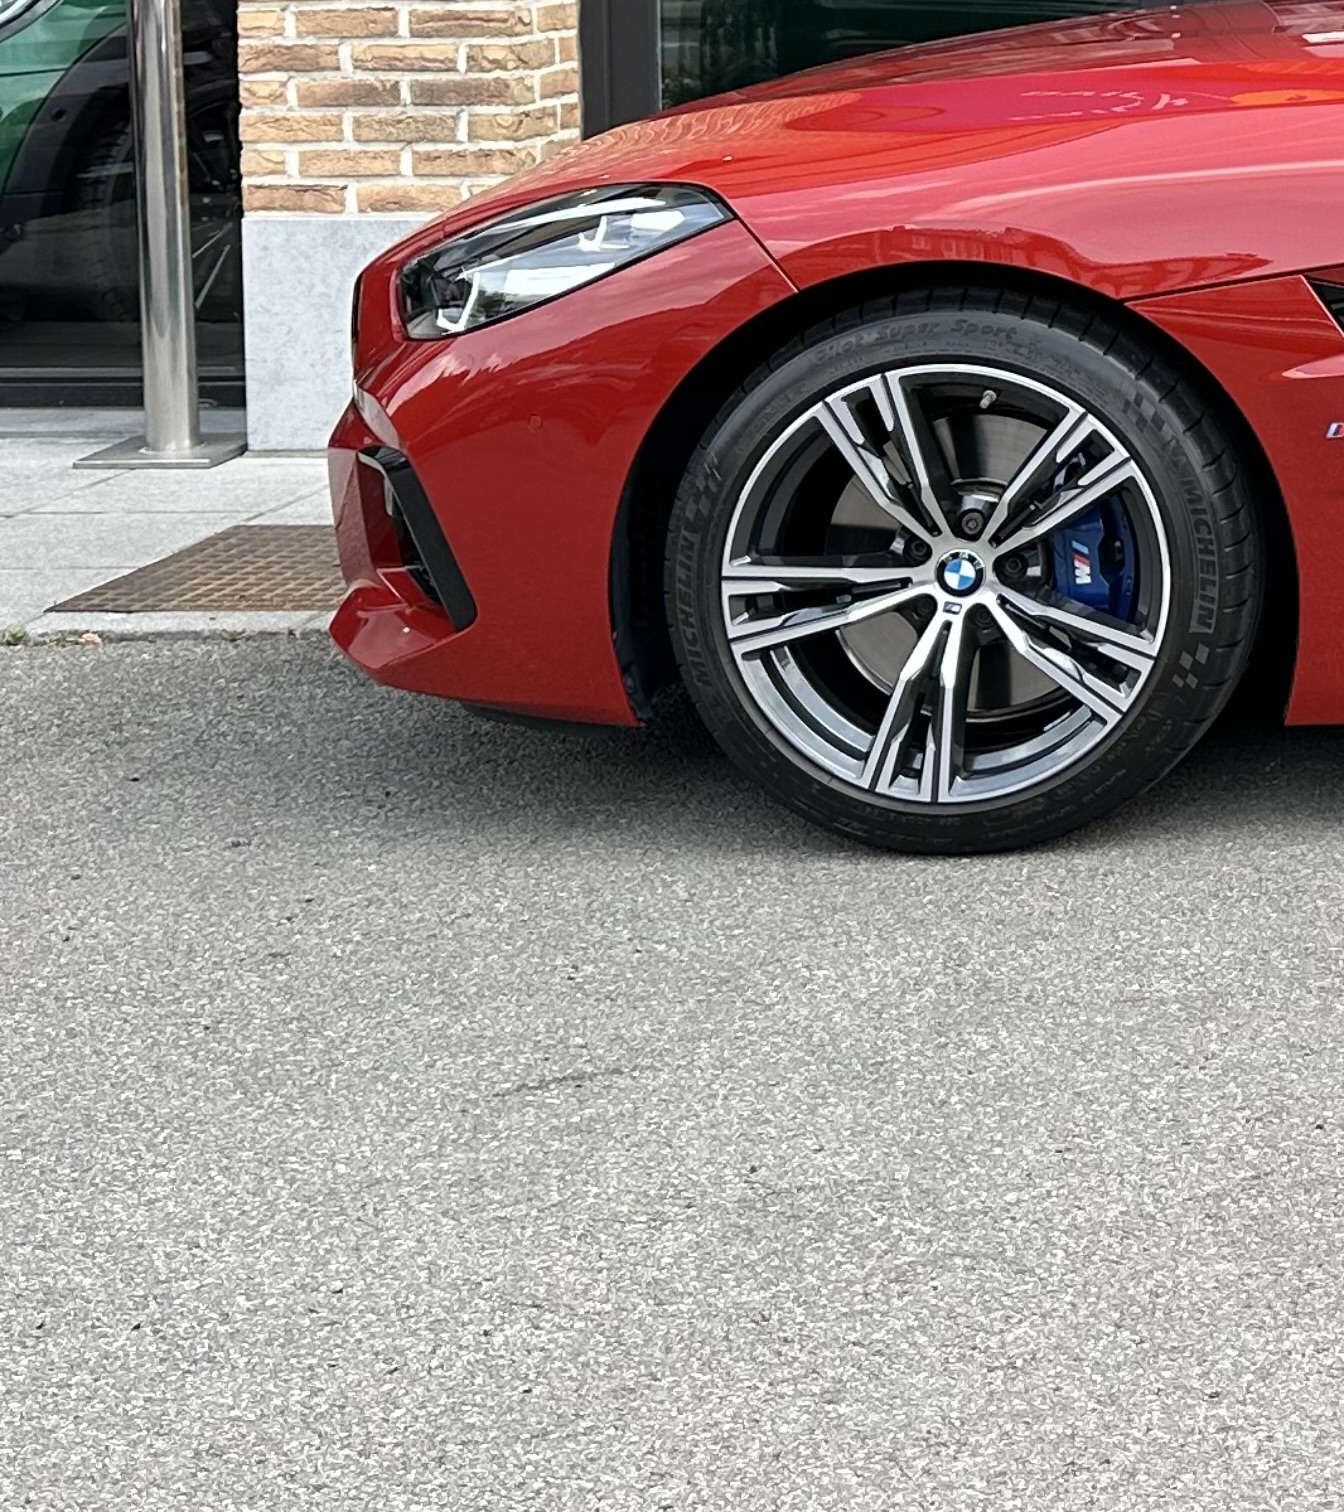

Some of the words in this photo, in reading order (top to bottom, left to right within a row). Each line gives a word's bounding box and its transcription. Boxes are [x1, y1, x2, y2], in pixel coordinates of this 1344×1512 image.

[949, 318, 1016, 340] Sport
[677, 524, 711, 688] MICHELIN
[1184, 473, 1217, 631] MICHELIN
